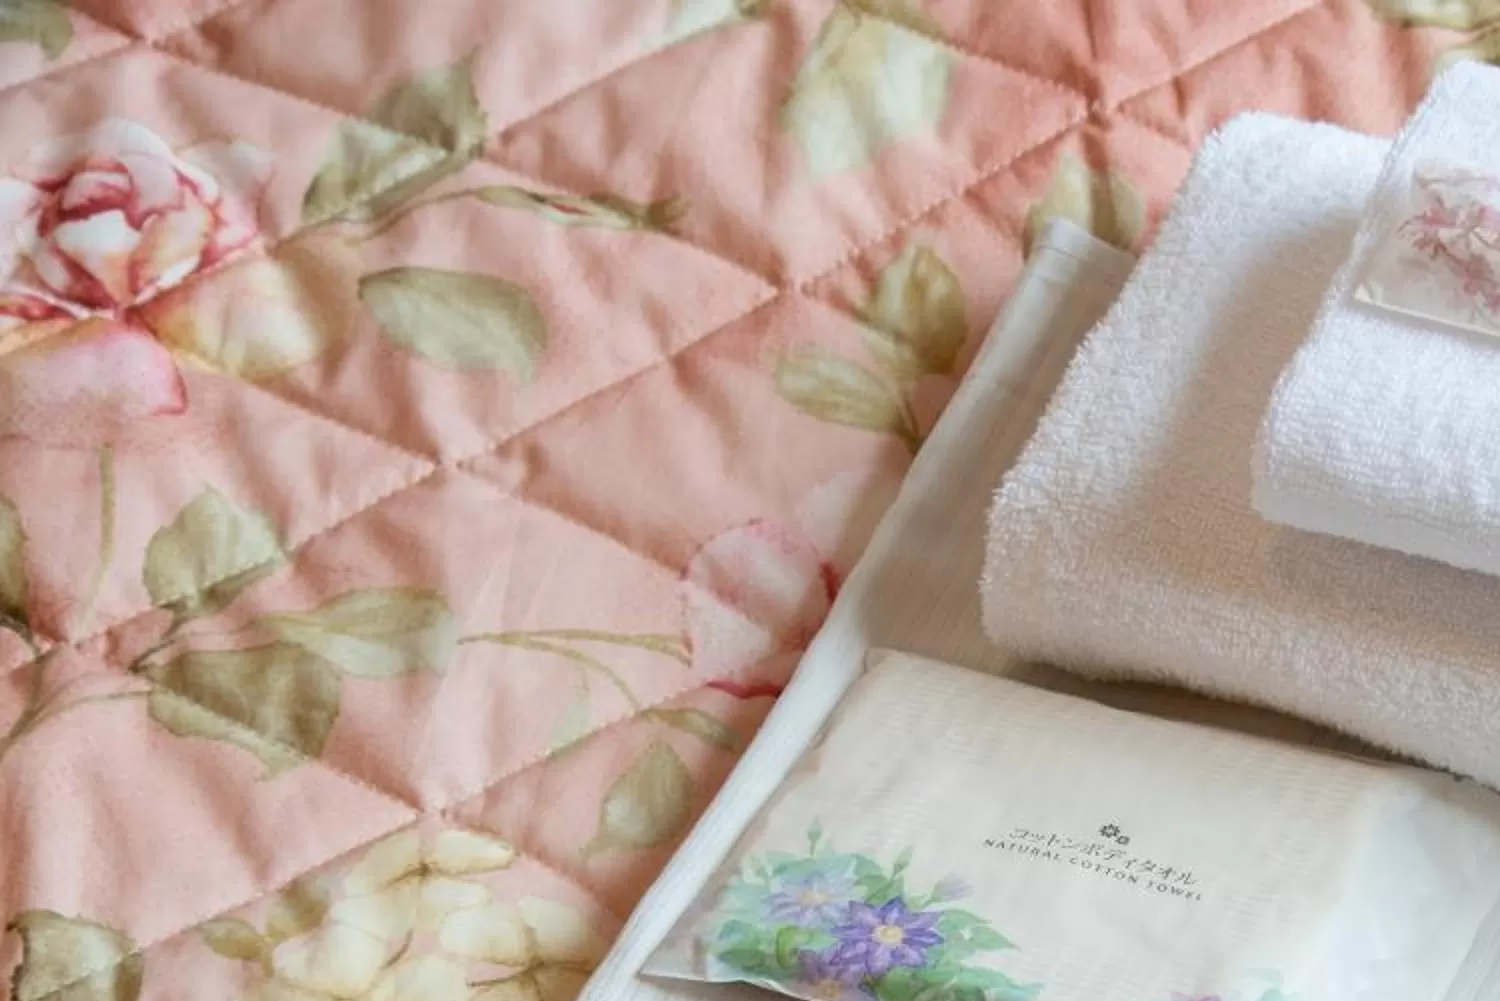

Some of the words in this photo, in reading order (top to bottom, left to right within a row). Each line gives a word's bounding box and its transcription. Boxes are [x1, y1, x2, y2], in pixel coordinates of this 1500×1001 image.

[983, 837, 1061, 861] NATURAL
[1068, 855, 1138, 884] COTTON
[1146, 878, 1201, 901] TOWEL
